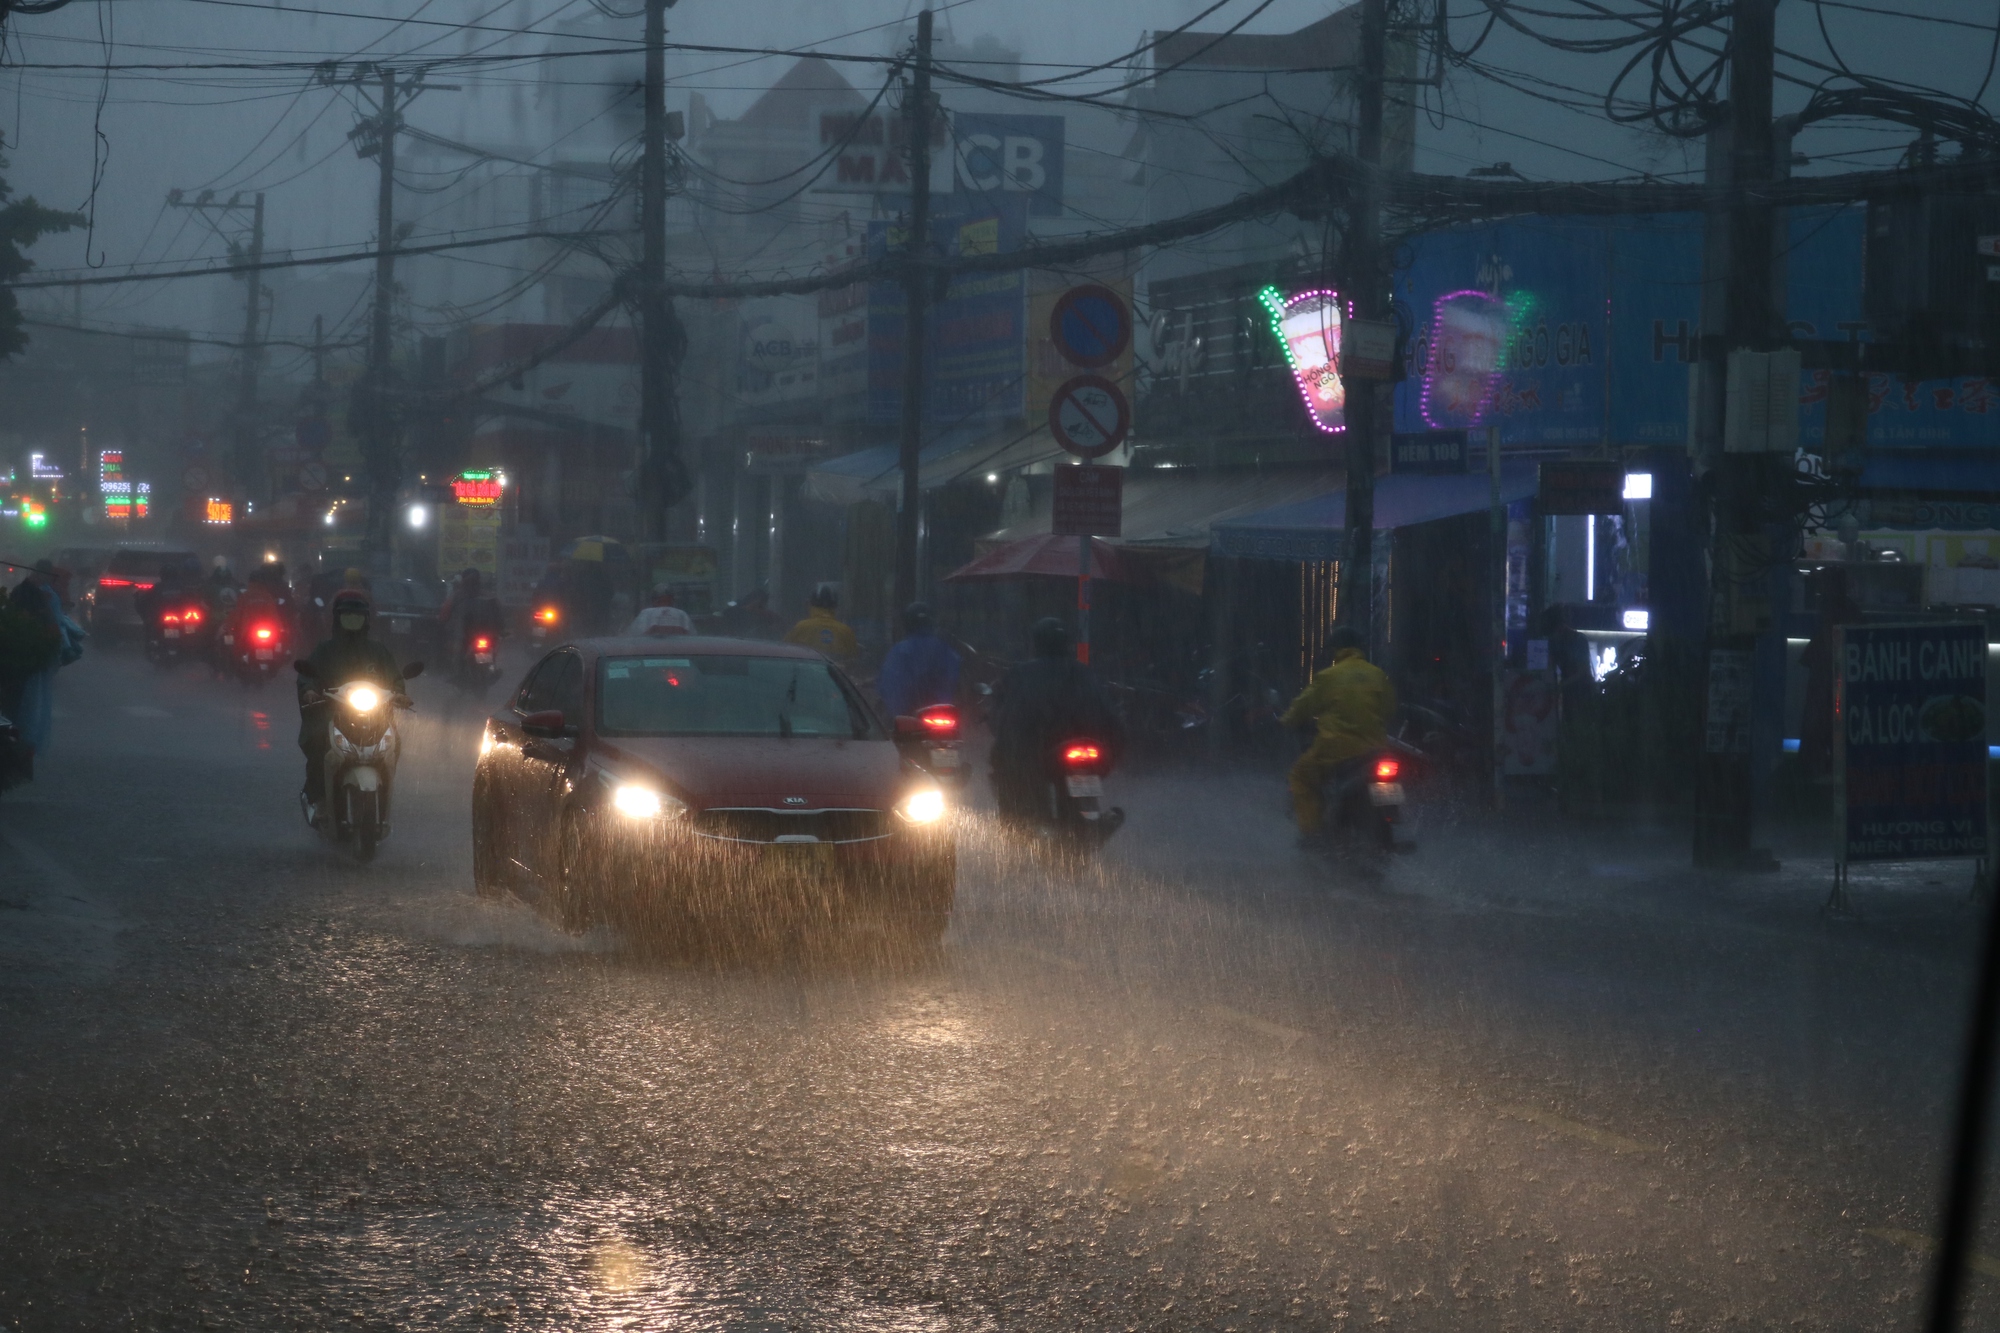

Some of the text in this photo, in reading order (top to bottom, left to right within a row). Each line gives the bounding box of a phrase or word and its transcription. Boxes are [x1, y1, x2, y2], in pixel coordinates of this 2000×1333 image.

[753, 340, 792, 357] ACB
[1555, 323, 1592, 367] GIA
[1432, 443, 1460, 461] 108
[1846, 632, 1984, 682] BÁNH CANH
[1848, 694, 1914, 745] CÁ LÓC
[1861, 819, 1973, 836] HƯƠNG VỊ
[1909, 837, 1986, 852] TRUNG
